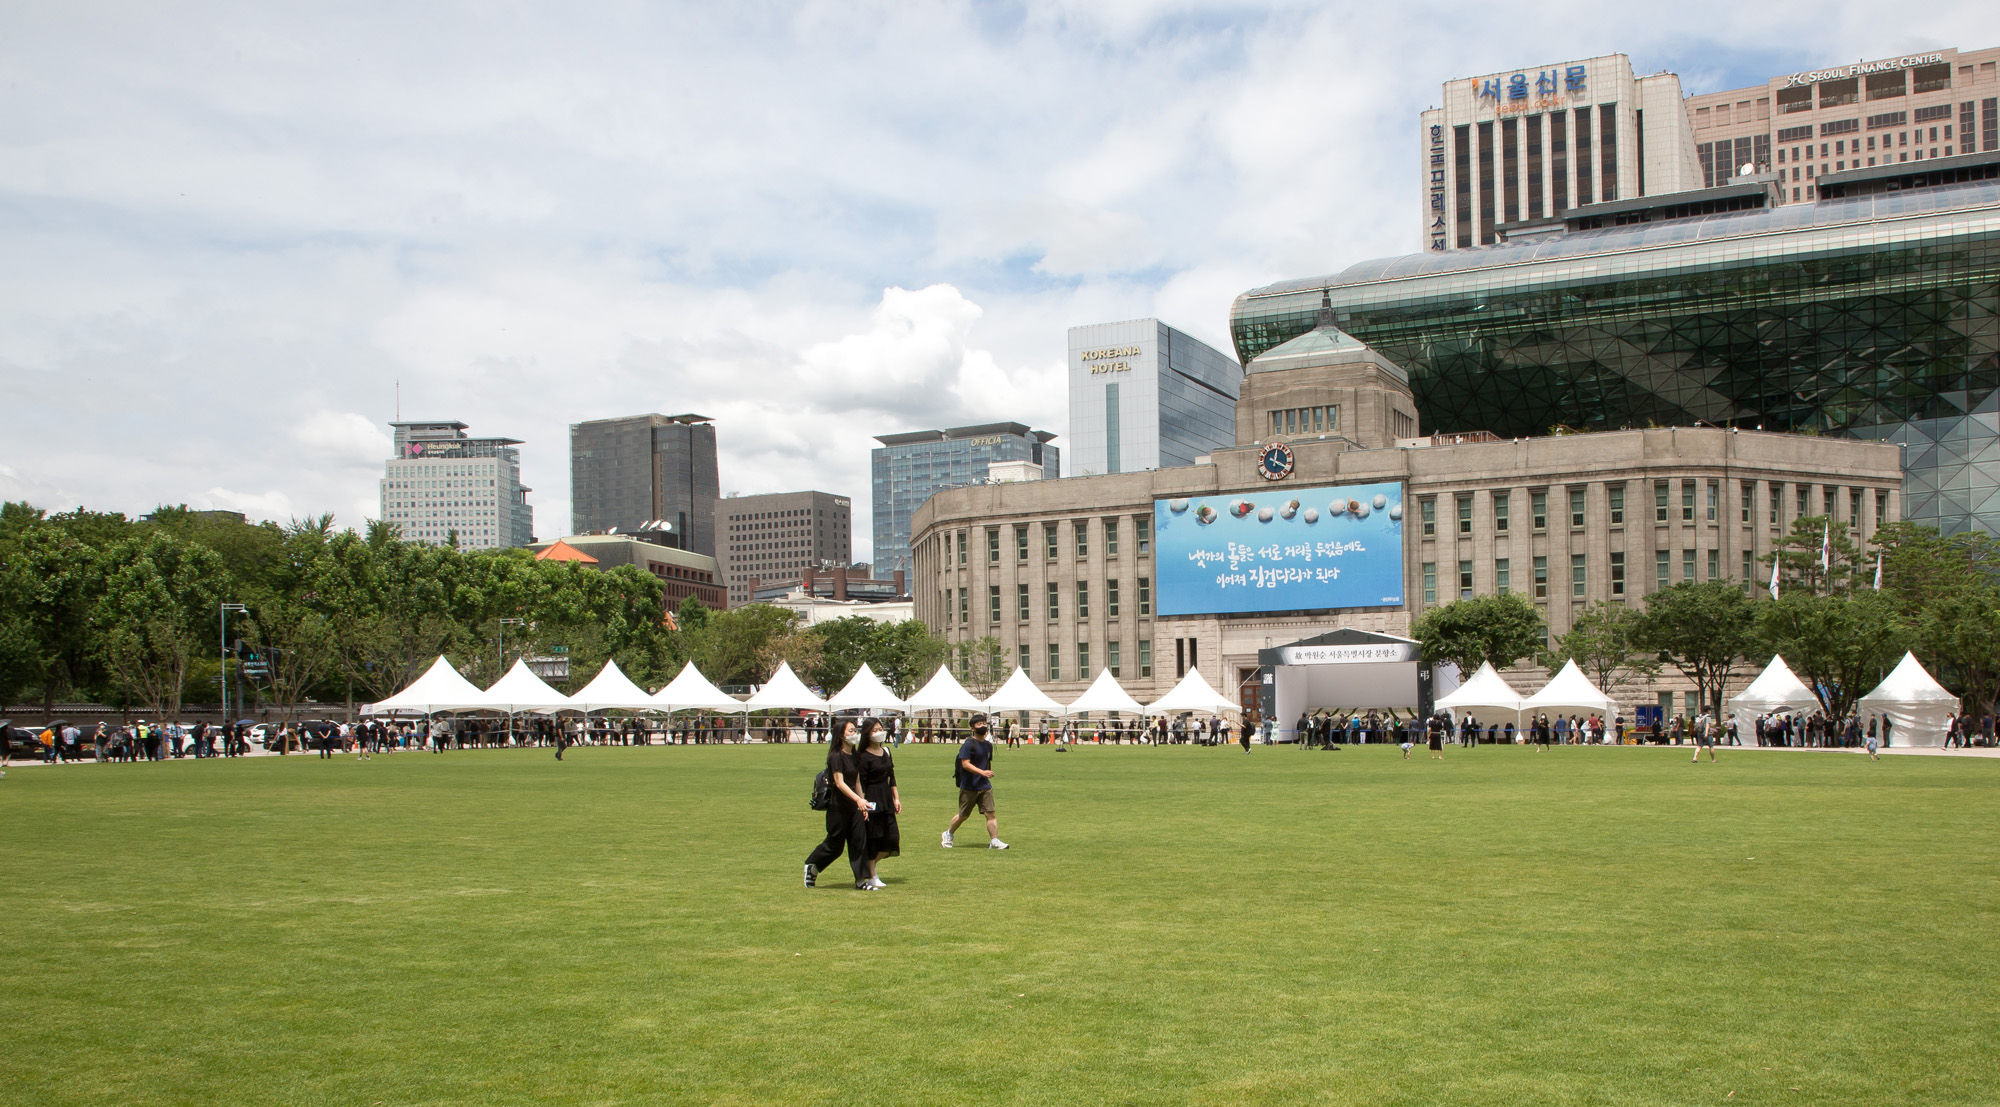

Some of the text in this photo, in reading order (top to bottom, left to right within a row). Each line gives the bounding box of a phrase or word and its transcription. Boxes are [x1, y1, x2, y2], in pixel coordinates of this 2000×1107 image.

[1809, 69, 1845, 83] SEOUL
[1849, 60, 1897, 76] FINANCE
[1900, 53, 1942, 68] CENTER
[1480, 65, 1587, 101] 서울신문
[1496, 94, 1565, 114] seoul.co.kr
[1081, 345, 1141, 361] KOREANA
[1090, 361, 1131, 374] HOTEL
[971, 435, 1001, 447] OFFICIA
[1188, 541, 1366, 570] 냇가의 돌들은 서로 거리를 두었음에도
[1216, 565, 1341, 588] 이어져 징검다리가 된다
